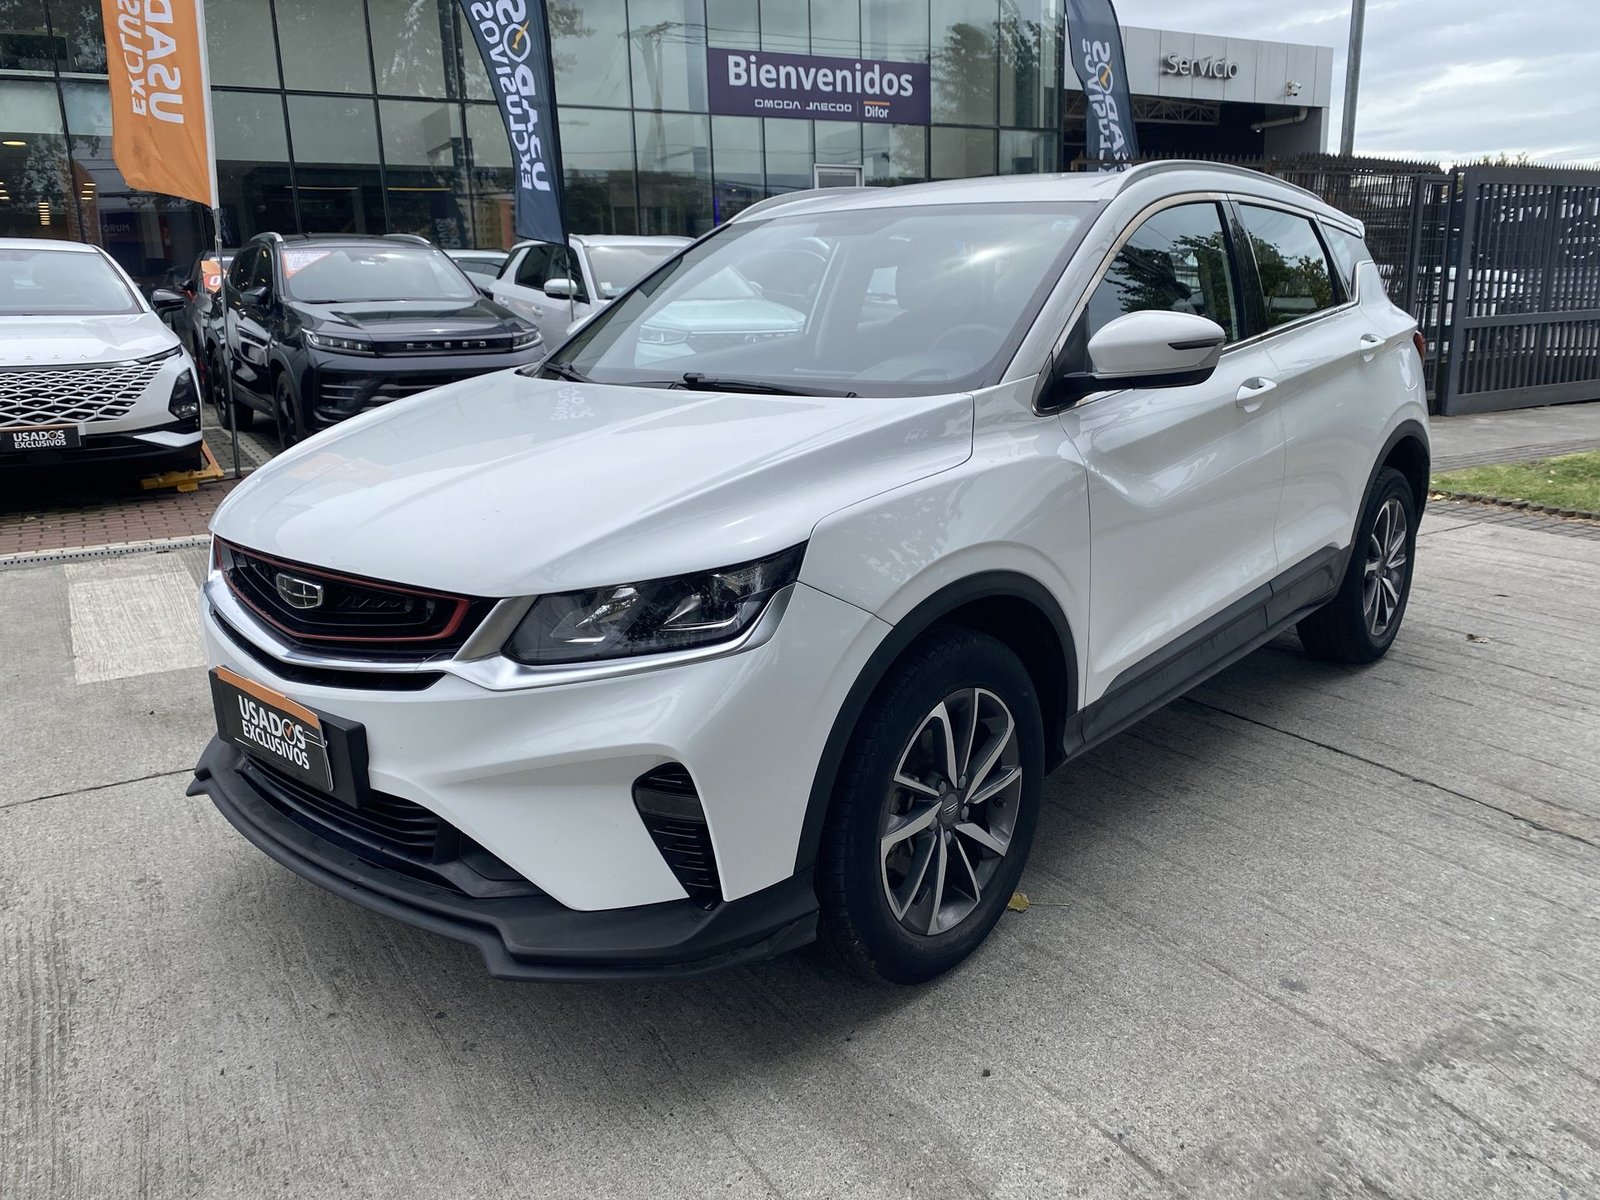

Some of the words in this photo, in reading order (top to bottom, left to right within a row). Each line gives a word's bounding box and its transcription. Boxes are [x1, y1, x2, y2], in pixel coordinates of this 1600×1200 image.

[727, 54, 914, 97] Bienvenidos
[1167, 53, 1239, 78] Servicio
[754, 98, 801, 110] OMODA
[805, 101, 852, 112] JAECOO
[864, 105, 889, 118] Difor
[13, 430, 65, 442] USADOS
[14, 438, 67, 449] EXCLUSIVOS
[238, 694, 306, 750] USADOS
[242, 719, 310, 770] EXCLUSIVOS
